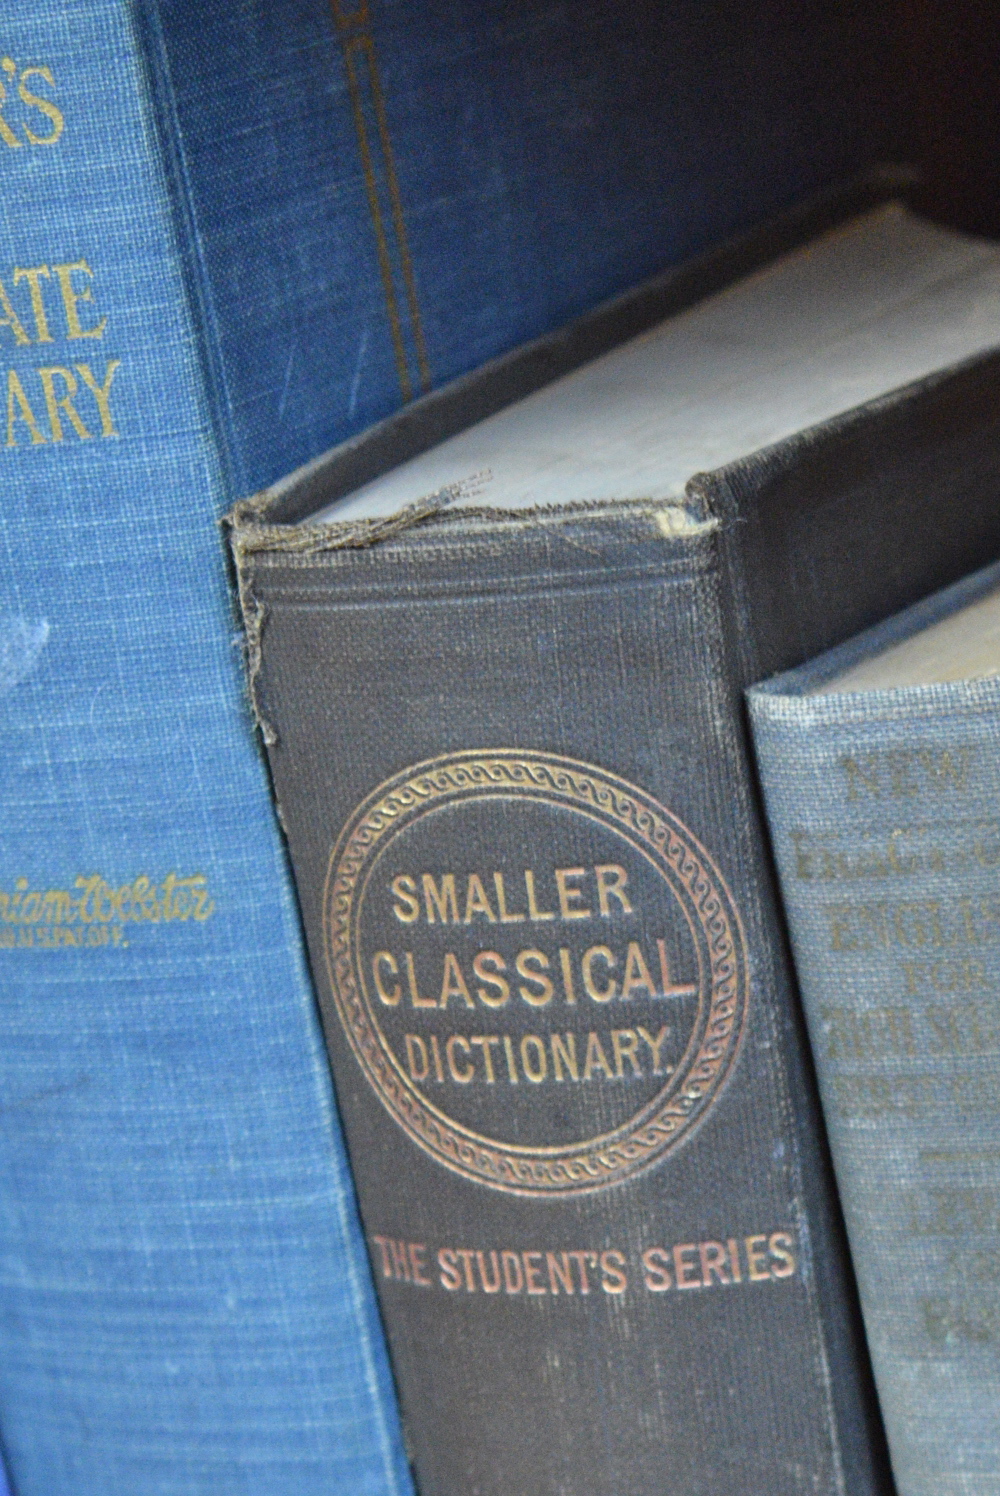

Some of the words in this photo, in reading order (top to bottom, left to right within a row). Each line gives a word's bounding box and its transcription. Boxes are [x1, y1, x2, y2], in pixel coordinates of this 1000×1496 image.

[6, 358, 121, 447] ARY
[391, 864, 634, 925] SMALLER
[372, 938, 697, 1009] CLASSICAL
[900, 958, 994, 996] FOR
[373, 1236, 432, 1288] THE
[438, 1247, 628, 1294] STUDENT'S
[643, 1232, 796, 1293] SERIES
